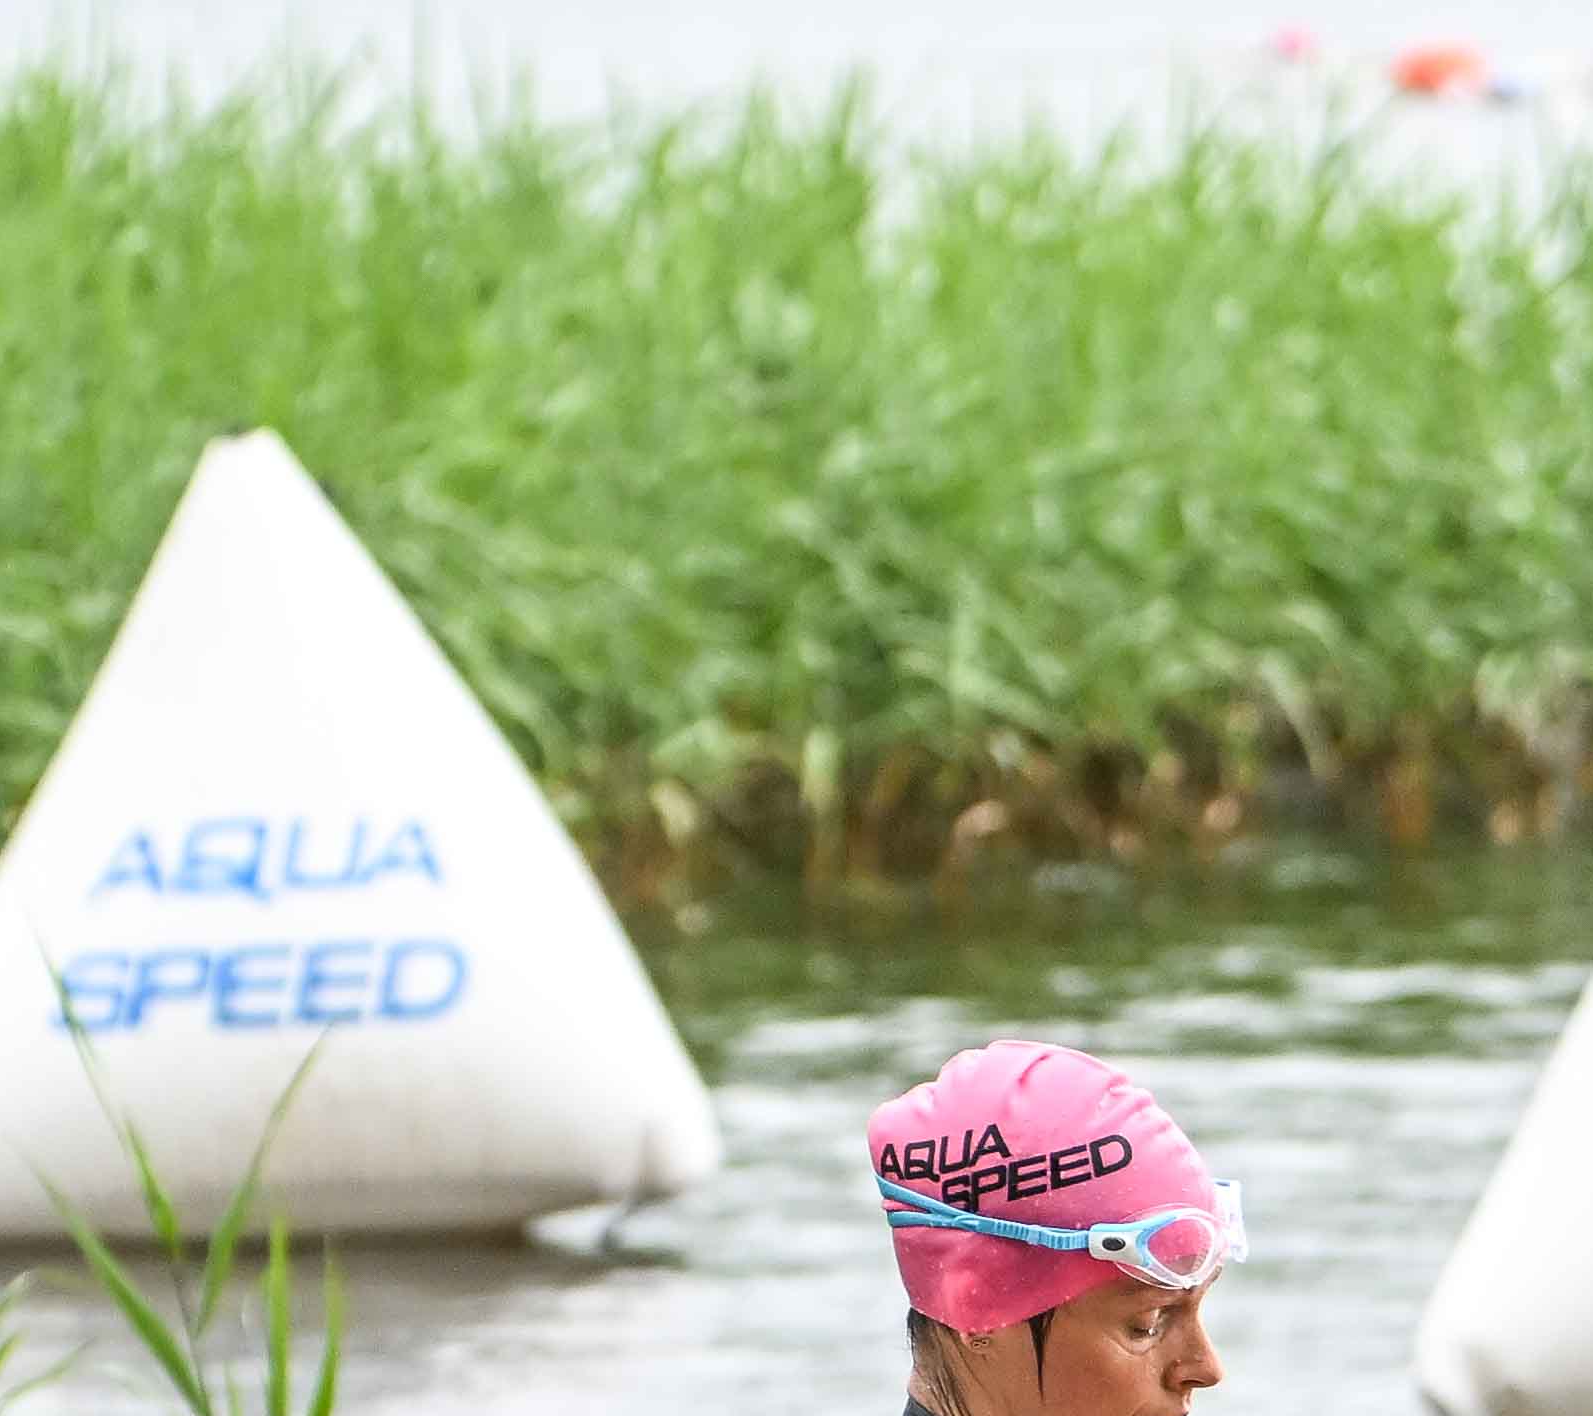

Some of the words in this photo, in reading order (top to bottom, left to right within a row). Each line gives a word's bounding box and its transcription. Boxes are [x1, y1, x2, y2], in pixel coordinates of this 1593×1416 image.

[90, 816, 444, 904] AQUA
[47, 938, 468, 1034] SPEED
[880, 1124, 1012, 1182] AQUA
[941, 1134, 1133, 1215] SPEED
